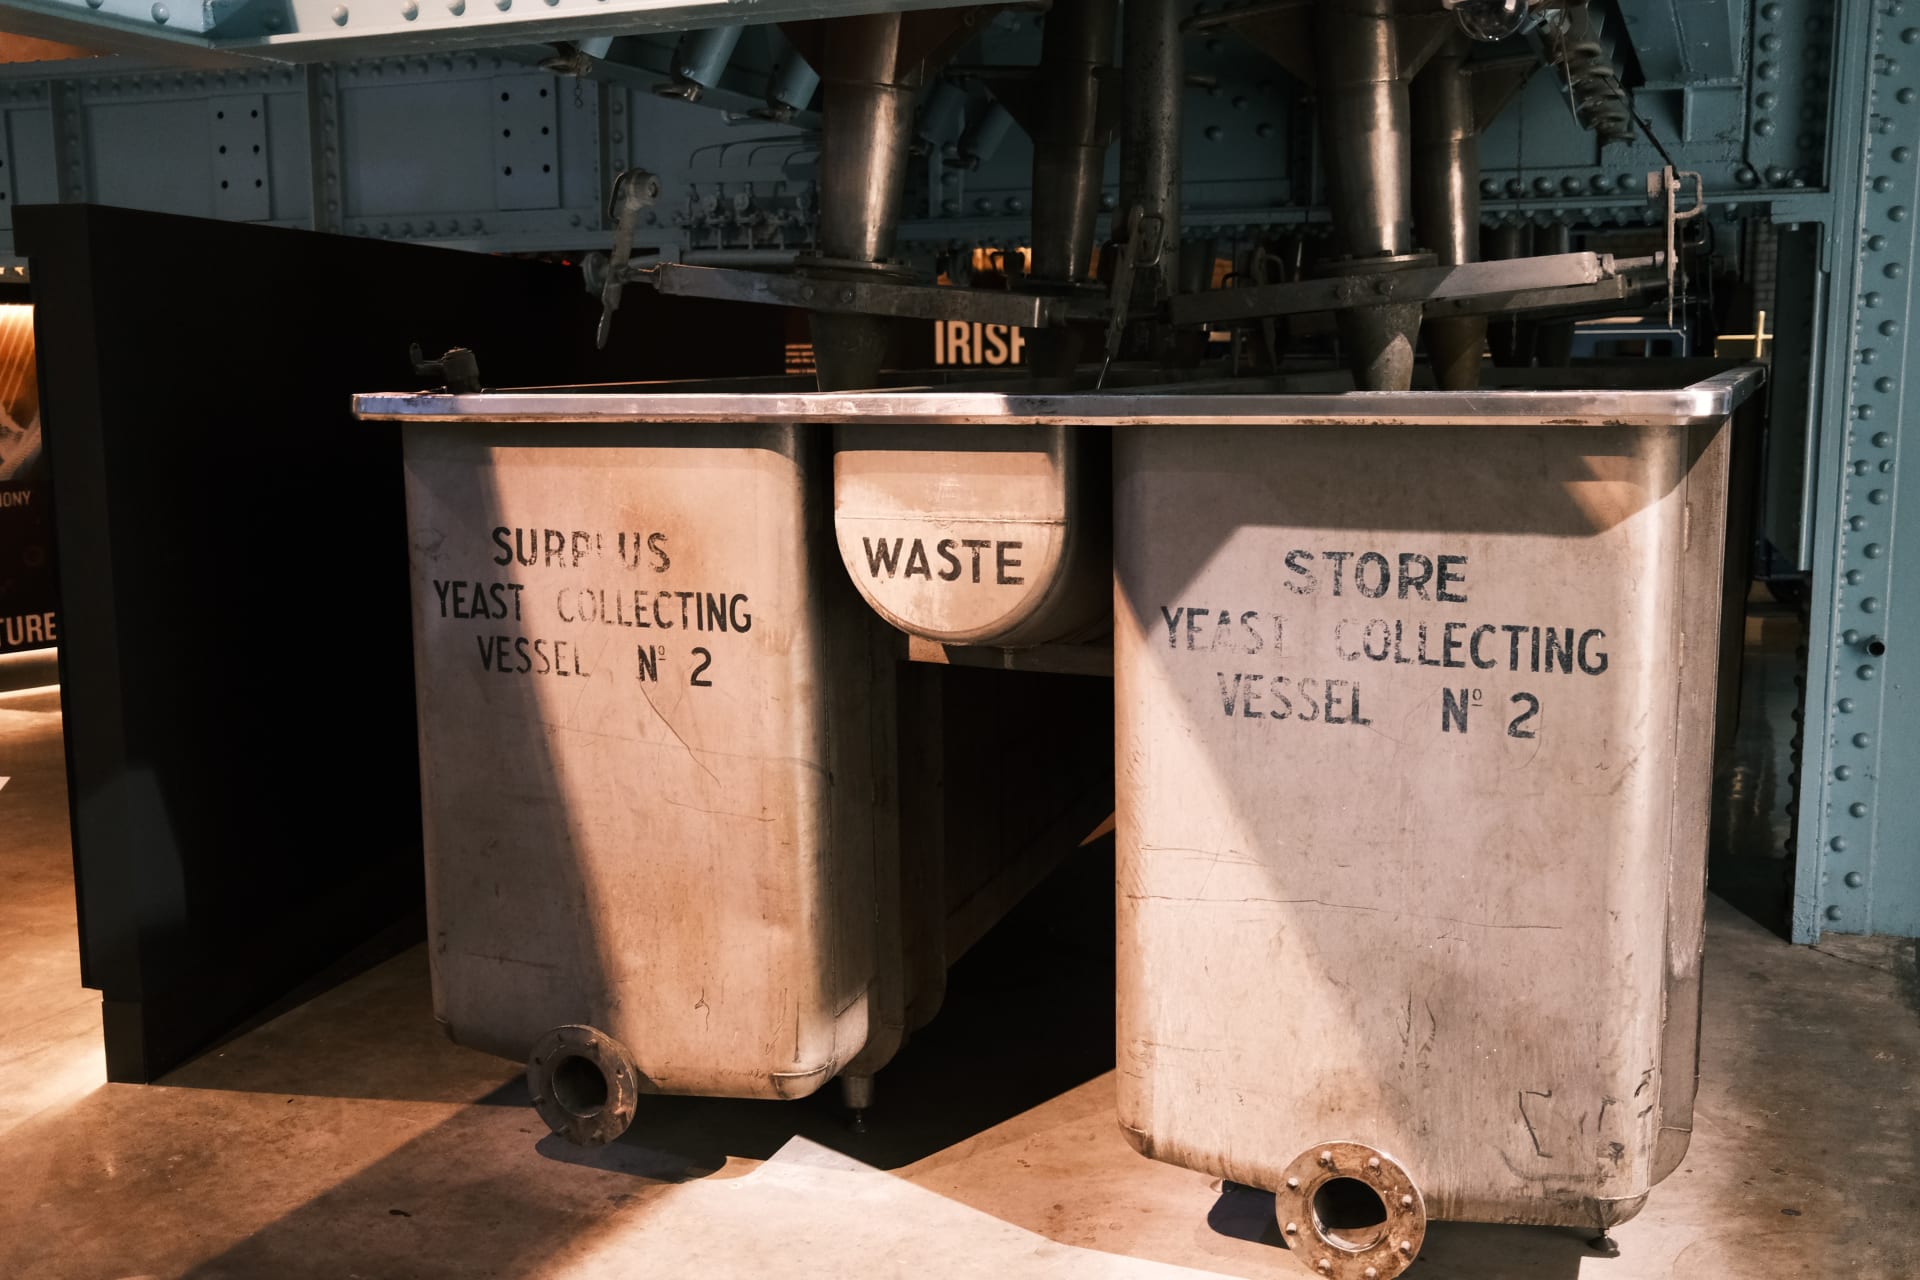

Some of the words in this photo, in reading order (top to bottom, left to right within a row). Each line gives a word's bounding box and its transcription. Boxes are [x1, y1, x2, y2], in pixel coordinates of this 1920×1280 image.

[0, 491, 31, 508] ONY
[862, 537, 1024, 585] WASTE
[1283, 549, 1469, 603] STORE
[0, 612, 57, 647] URE
[433, 580, 525, 621] YEAST
[557, 587, 752, 633] COLLECTING
[477, 635, 591, 677] VESSEL
[690, 647, 713, 687] 2
[1334, 617, 1609, 675] COLLECTING
[1216, 672, 1372, 725] VESSEL
[1506, 692, 1541, 739] 2
